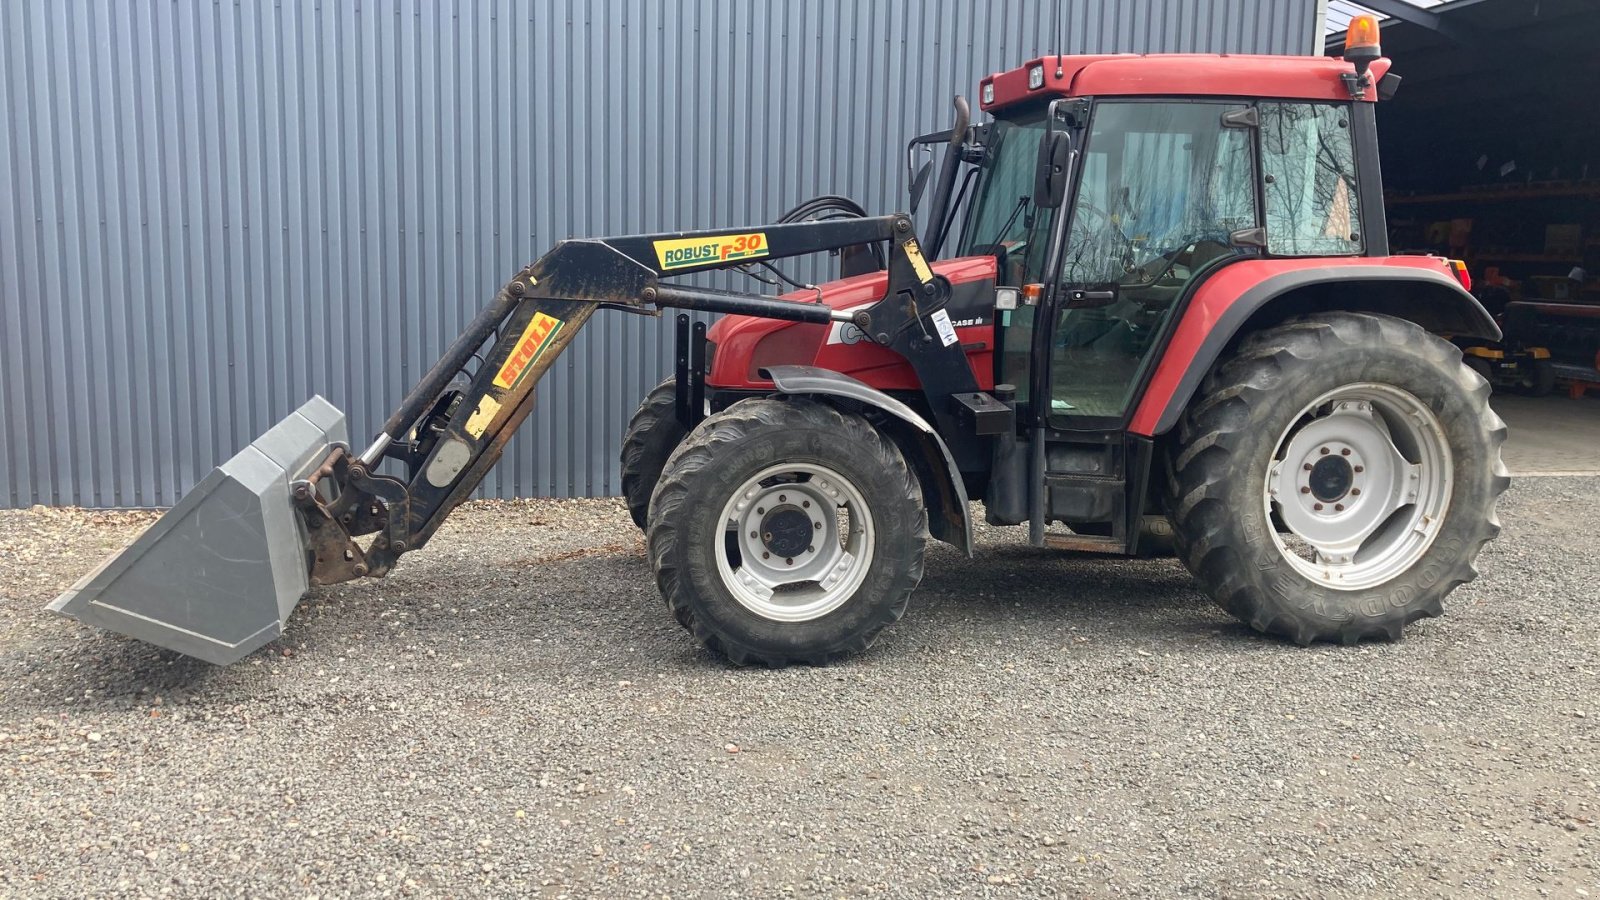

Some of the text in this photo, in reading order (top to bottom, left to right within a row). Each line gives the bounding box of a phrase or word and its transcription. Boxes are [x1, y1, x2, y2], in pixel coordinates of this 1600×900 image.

[665, 235, 761, 262] ROBUST F30
[501, 317, 555, 385] STOLL
[1240, 512, 1464, 622] GOODYEAR
